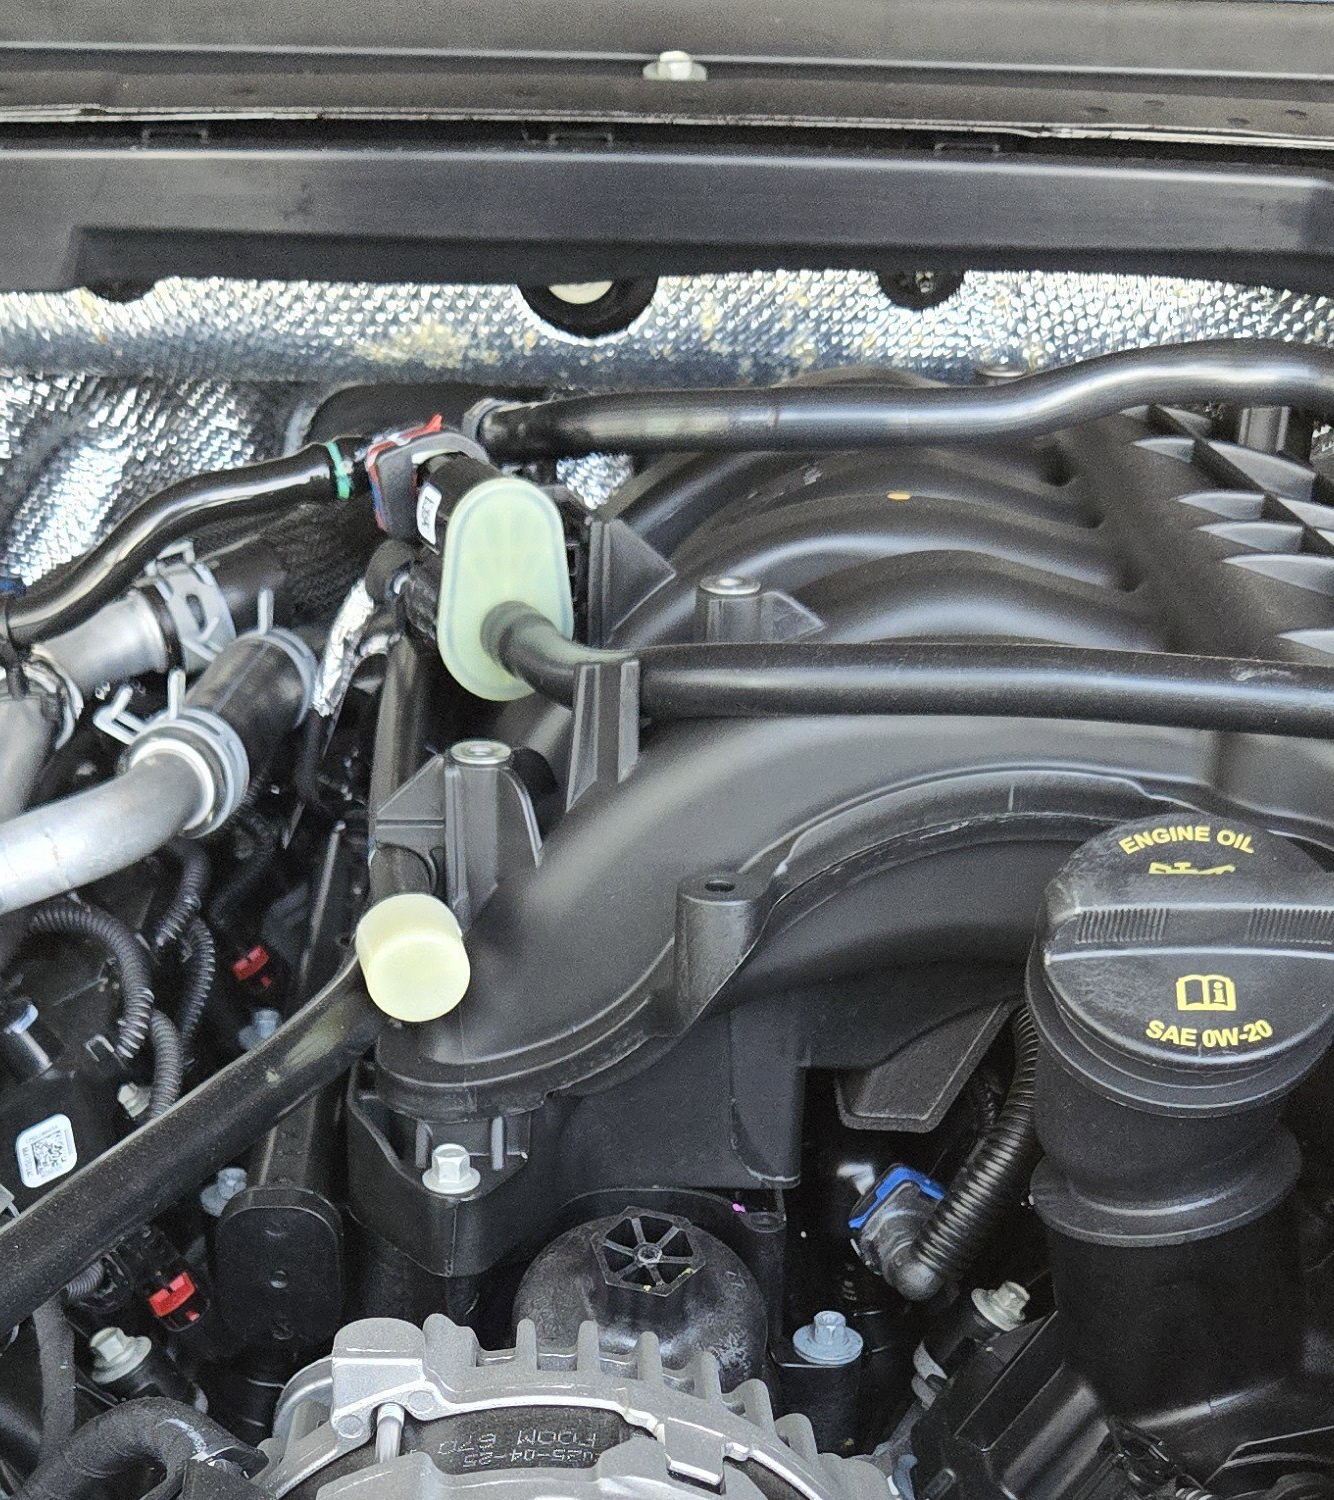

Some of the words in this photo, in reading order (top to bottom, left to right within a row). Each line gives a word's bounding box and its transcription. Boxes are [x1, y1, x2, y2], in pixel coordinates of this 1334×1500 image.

[1118, 825, 1211, 855] ENGINE
[1216, 829, 1255, 854] OIL
[1145, 1019, 1198, 1047] SAE
[1202, 1019, 1273, 1048] 0W-20
